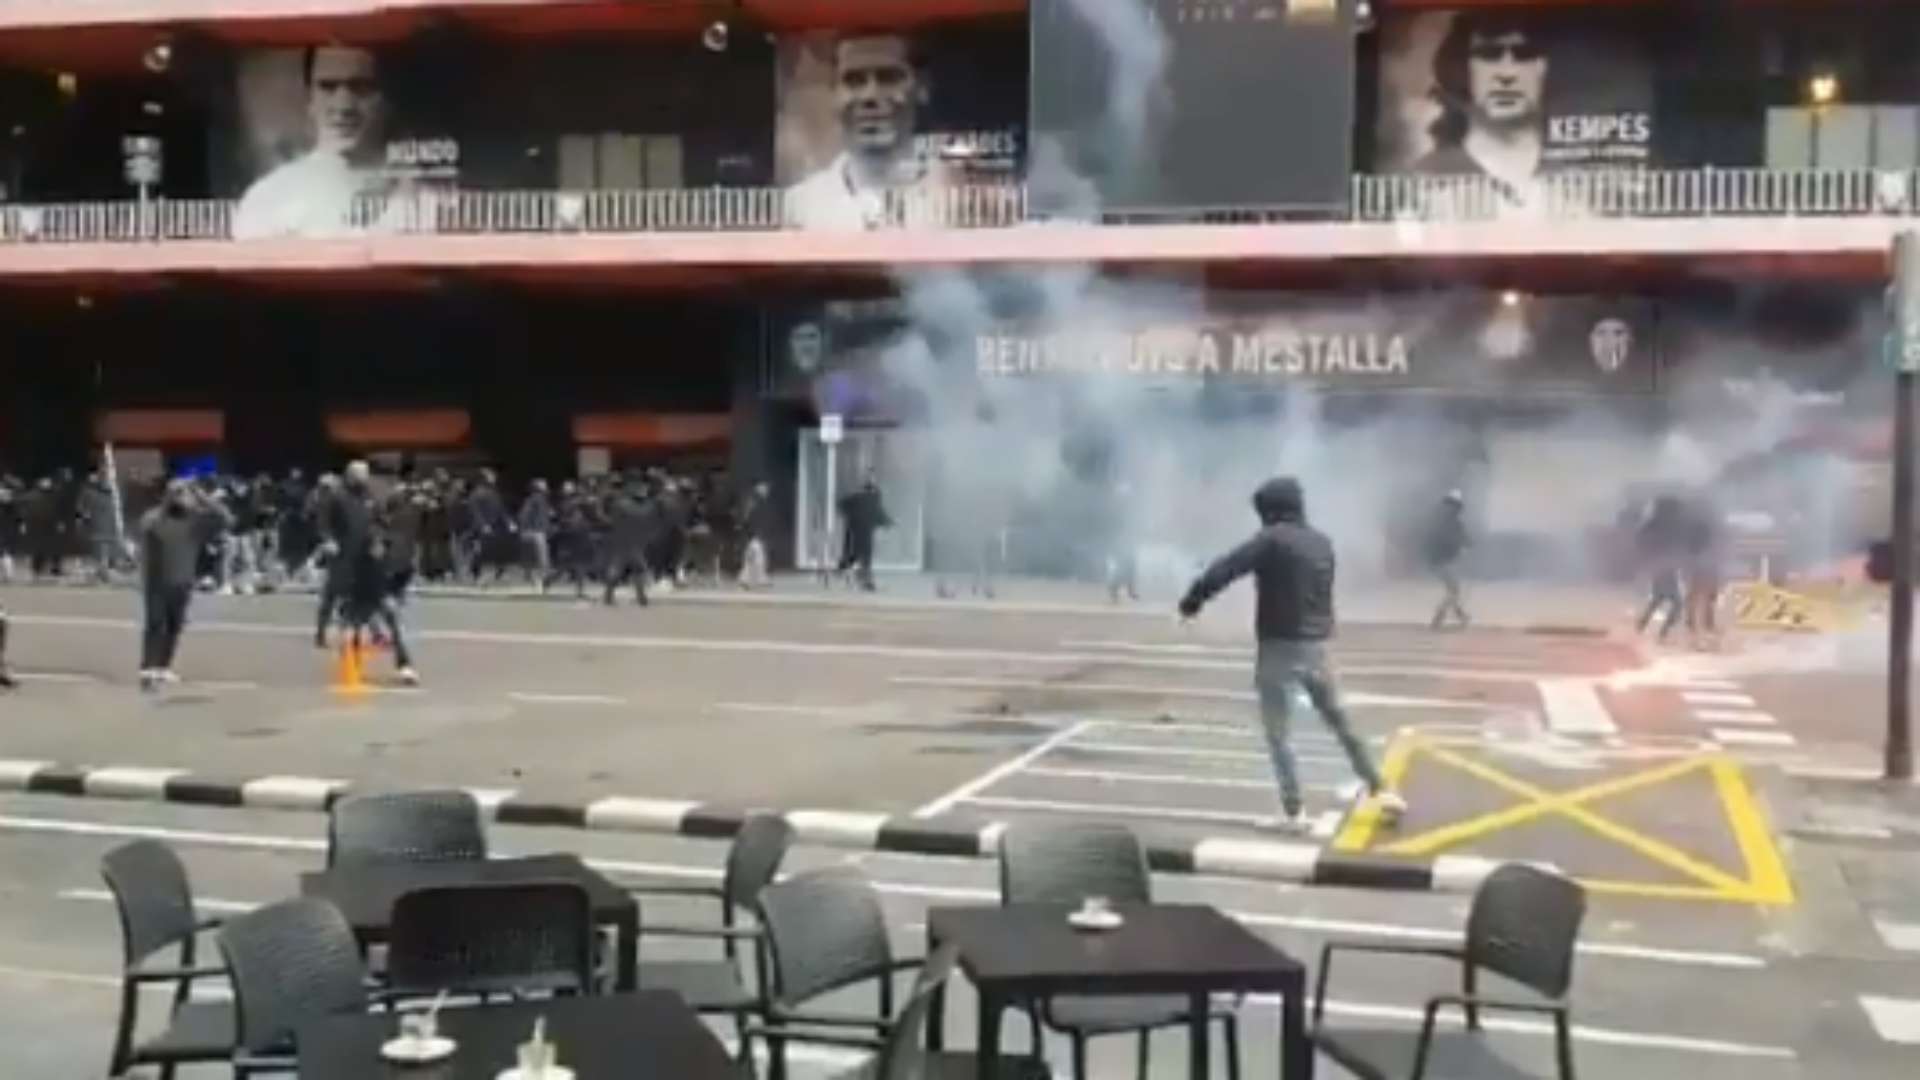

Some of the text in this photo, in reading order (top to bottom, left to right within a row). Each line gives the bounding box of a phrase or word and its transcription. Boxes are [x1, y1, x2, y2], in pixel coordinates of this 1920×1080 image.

[1549, 113, 1650, 142] KEMPES
[1199, 333, 1219, 374] A
[1232, 333, 1408, 375] MESTALLA
